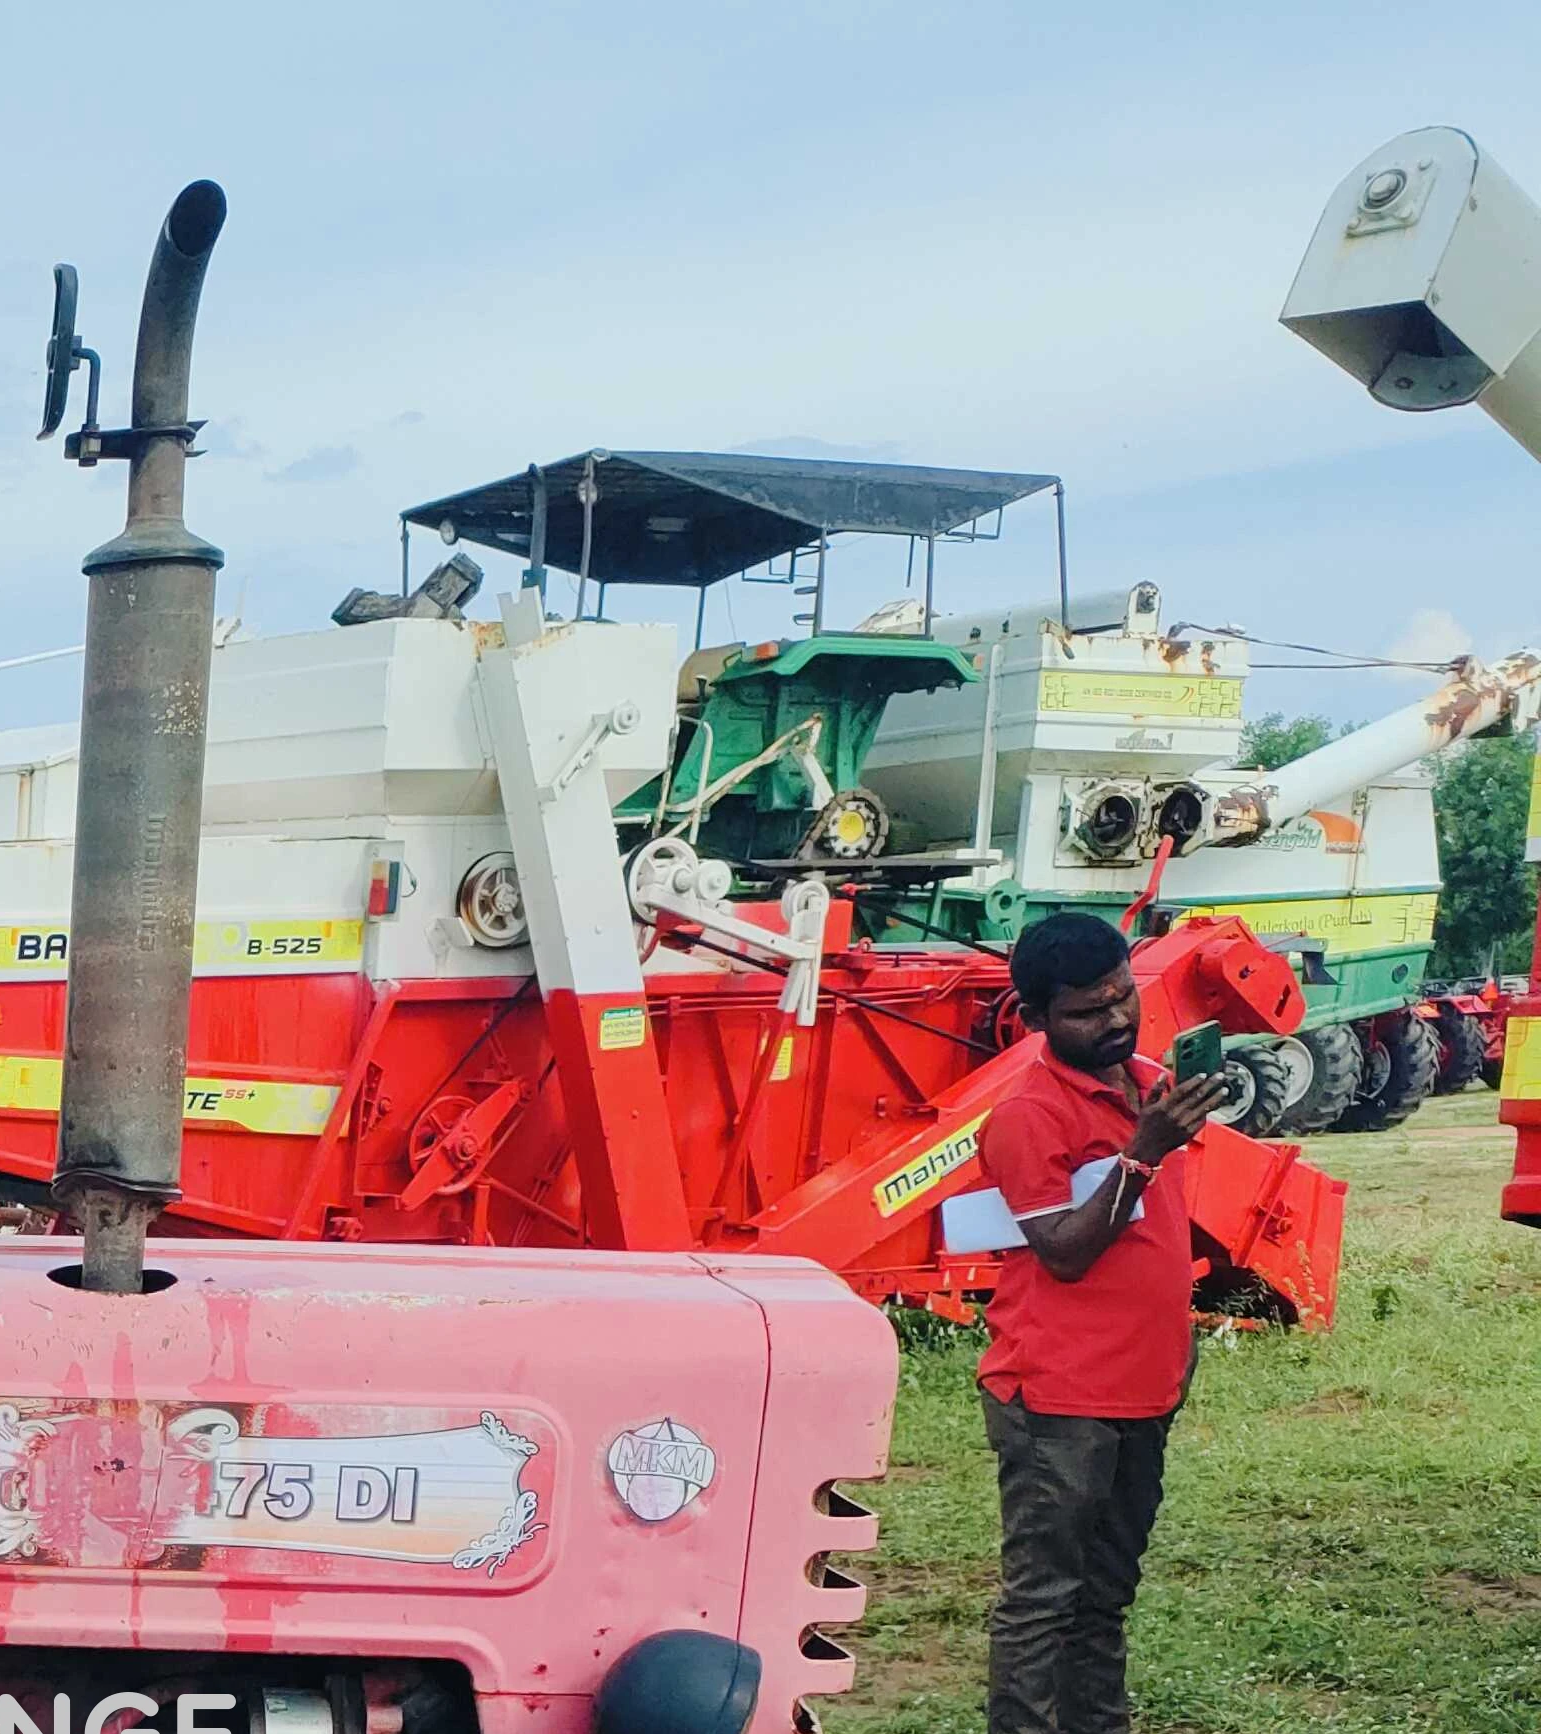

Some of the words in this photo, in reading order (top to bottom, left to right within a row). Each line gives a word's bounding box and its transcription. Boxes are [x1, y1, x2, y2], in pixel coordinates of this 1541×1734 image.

[246, 937, 323, 956] B-525
[615, 1435, 708, 1482] MKM
[335, 1464, 420, 1524] DI
